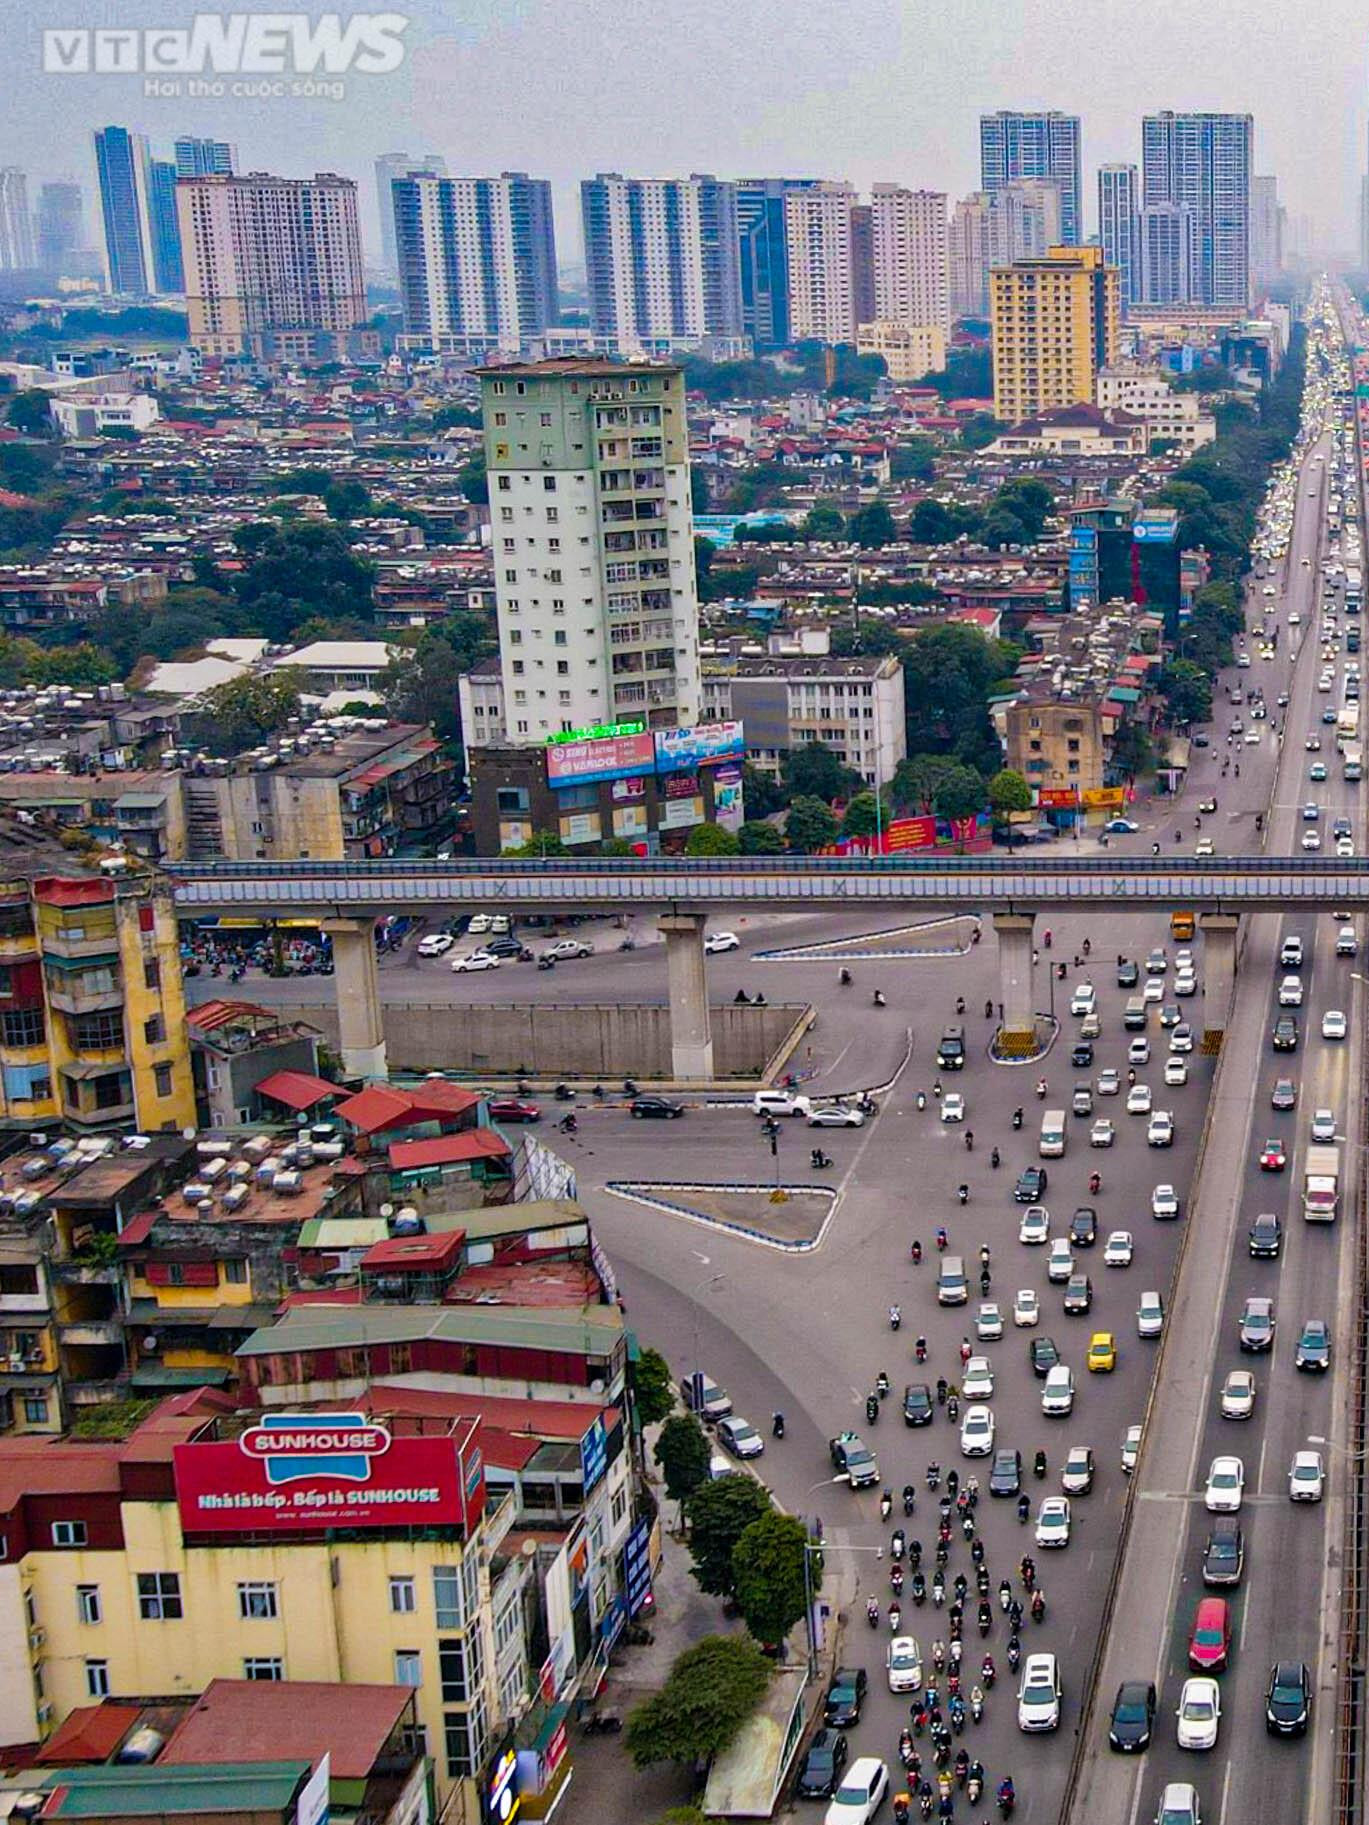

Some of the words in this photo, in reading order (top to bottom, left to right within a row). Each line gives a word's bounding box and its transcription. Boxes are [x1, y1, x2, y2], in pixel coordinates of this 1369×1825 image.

[254, 1433, 377, 1450] SUNHOUSE
[234, 1493, 251, 1508] là
[294, 1489, 326, 1508] Bếp
[327, 1490, 344, 1506] là
[346, 1488, 440, 1504] SUNHOUSE
